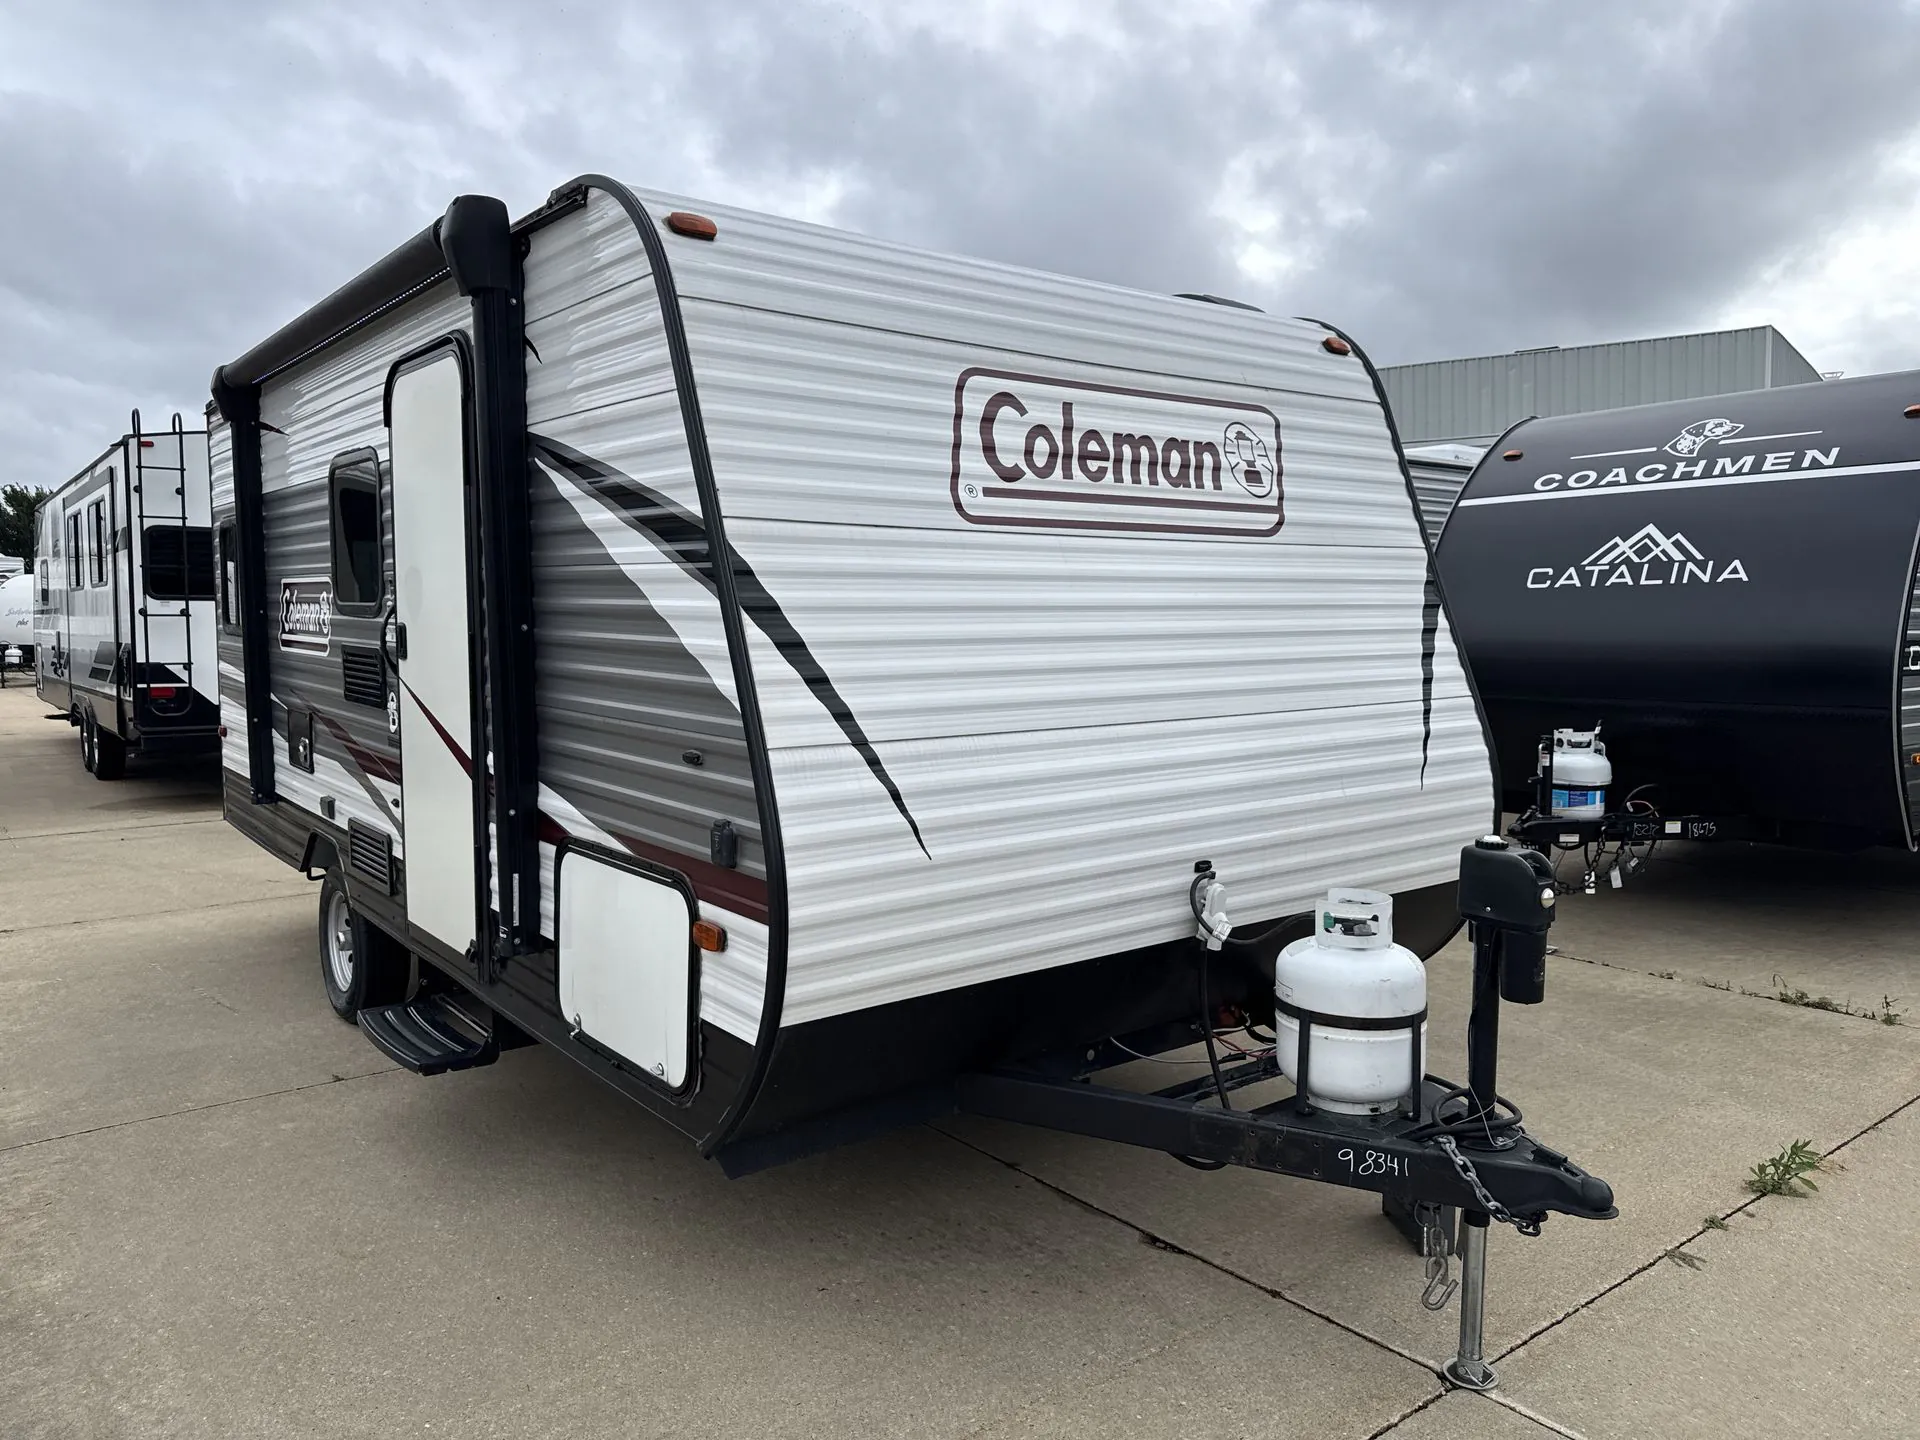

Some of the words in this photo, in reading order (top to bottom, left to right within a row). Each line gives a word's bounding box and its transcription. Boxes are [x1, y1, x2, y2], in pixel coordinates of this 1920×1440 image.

[979, 391, 1223, 491] Coleman
[1533, 446, 1841, 492] COACHMEN
[1526, 558, 1750, 589] CATALINA
[282, 588, 320, 633] Coleman
[1337, 1148, 1409, 1177] 98341
